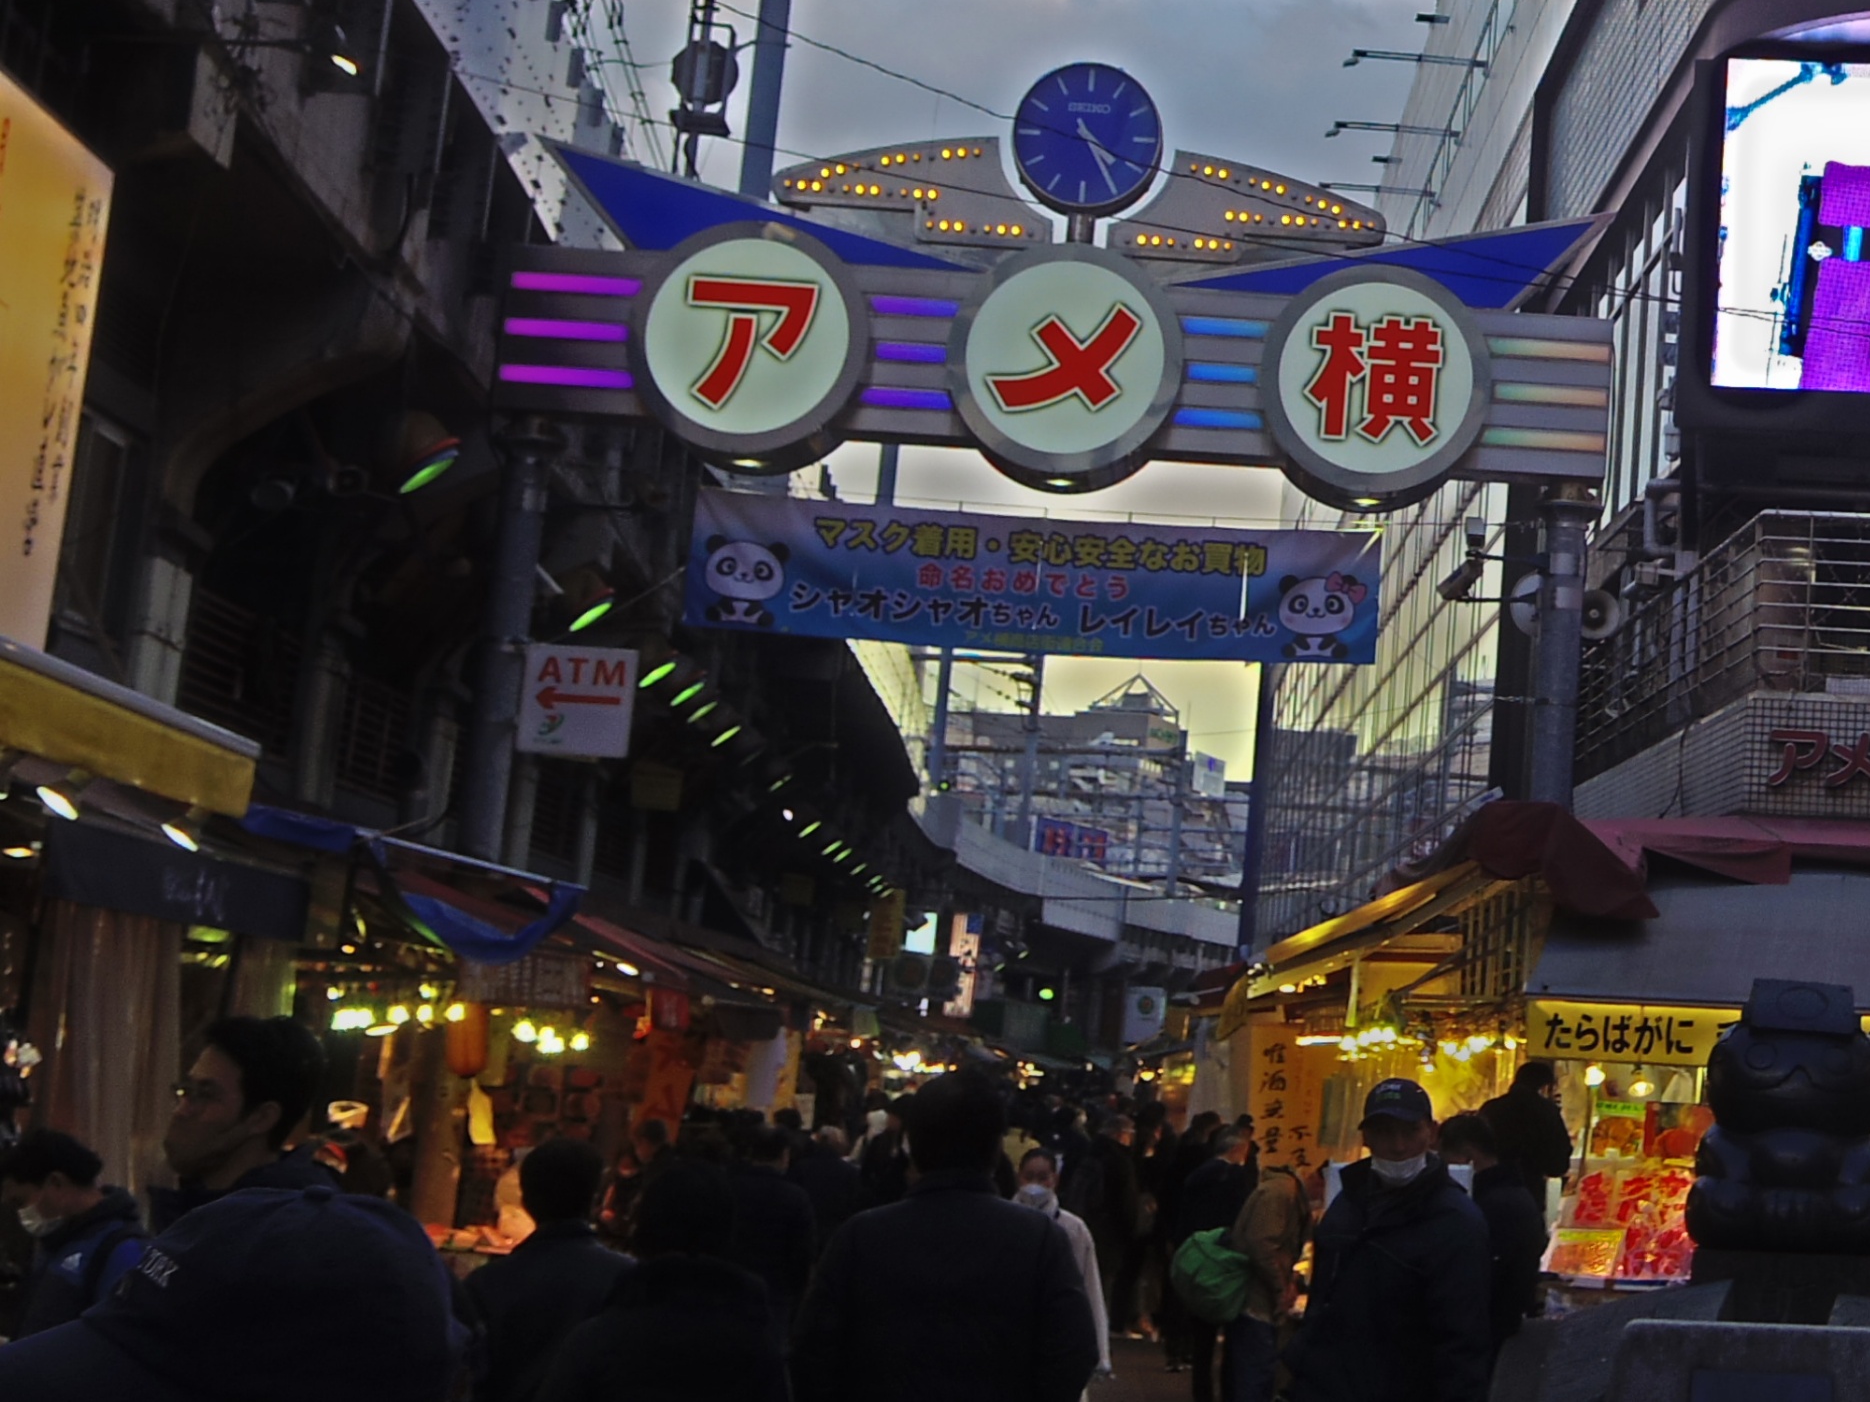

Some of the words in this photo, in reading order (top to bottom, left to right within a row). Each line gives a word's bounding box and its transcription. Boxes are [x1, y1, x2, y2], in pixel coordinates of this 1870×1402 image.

[1068, 102, 1111, 114] SEIKO
[686, 274, 1444, 446] アメ横
[815, 517, 1267, 575] マスク着用・安心安全なお買物
[918, 563, 1129, 599] 命名おめでとう
[789, 582, 1059, 628] シャオシャオちゃん
[1079, 604, 1276, 640] レイレイちゃん
[538, 656, 627, 687] ATM
[1544, 1012, 1694, 1054] たらばがに
